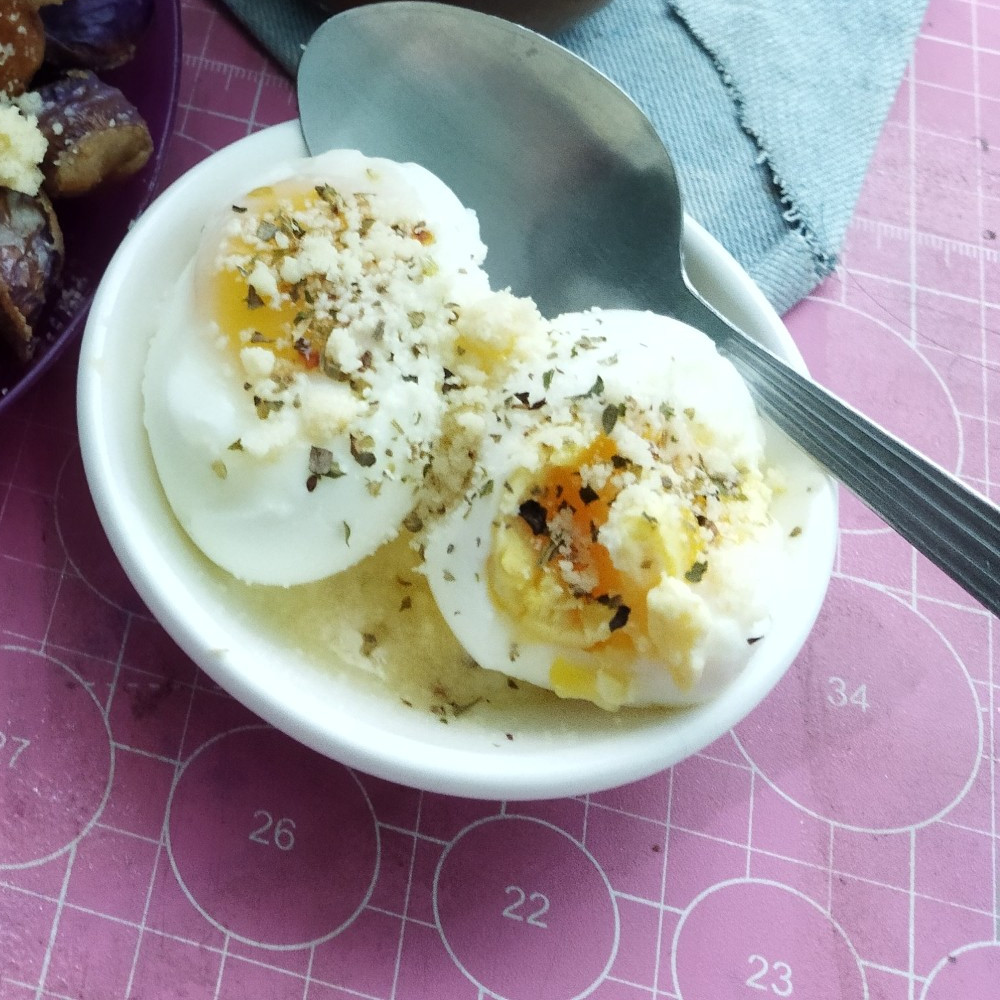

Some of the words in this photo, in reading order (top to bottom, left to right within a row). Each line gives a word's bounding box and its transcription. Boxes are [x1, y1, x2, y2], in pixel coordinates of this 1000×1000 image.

[828, 676, 870, 712] 34
[248, 811, 296, 850] 26
[502, 885, 550, 928] 22
[745, 954, 793, 997] 23
